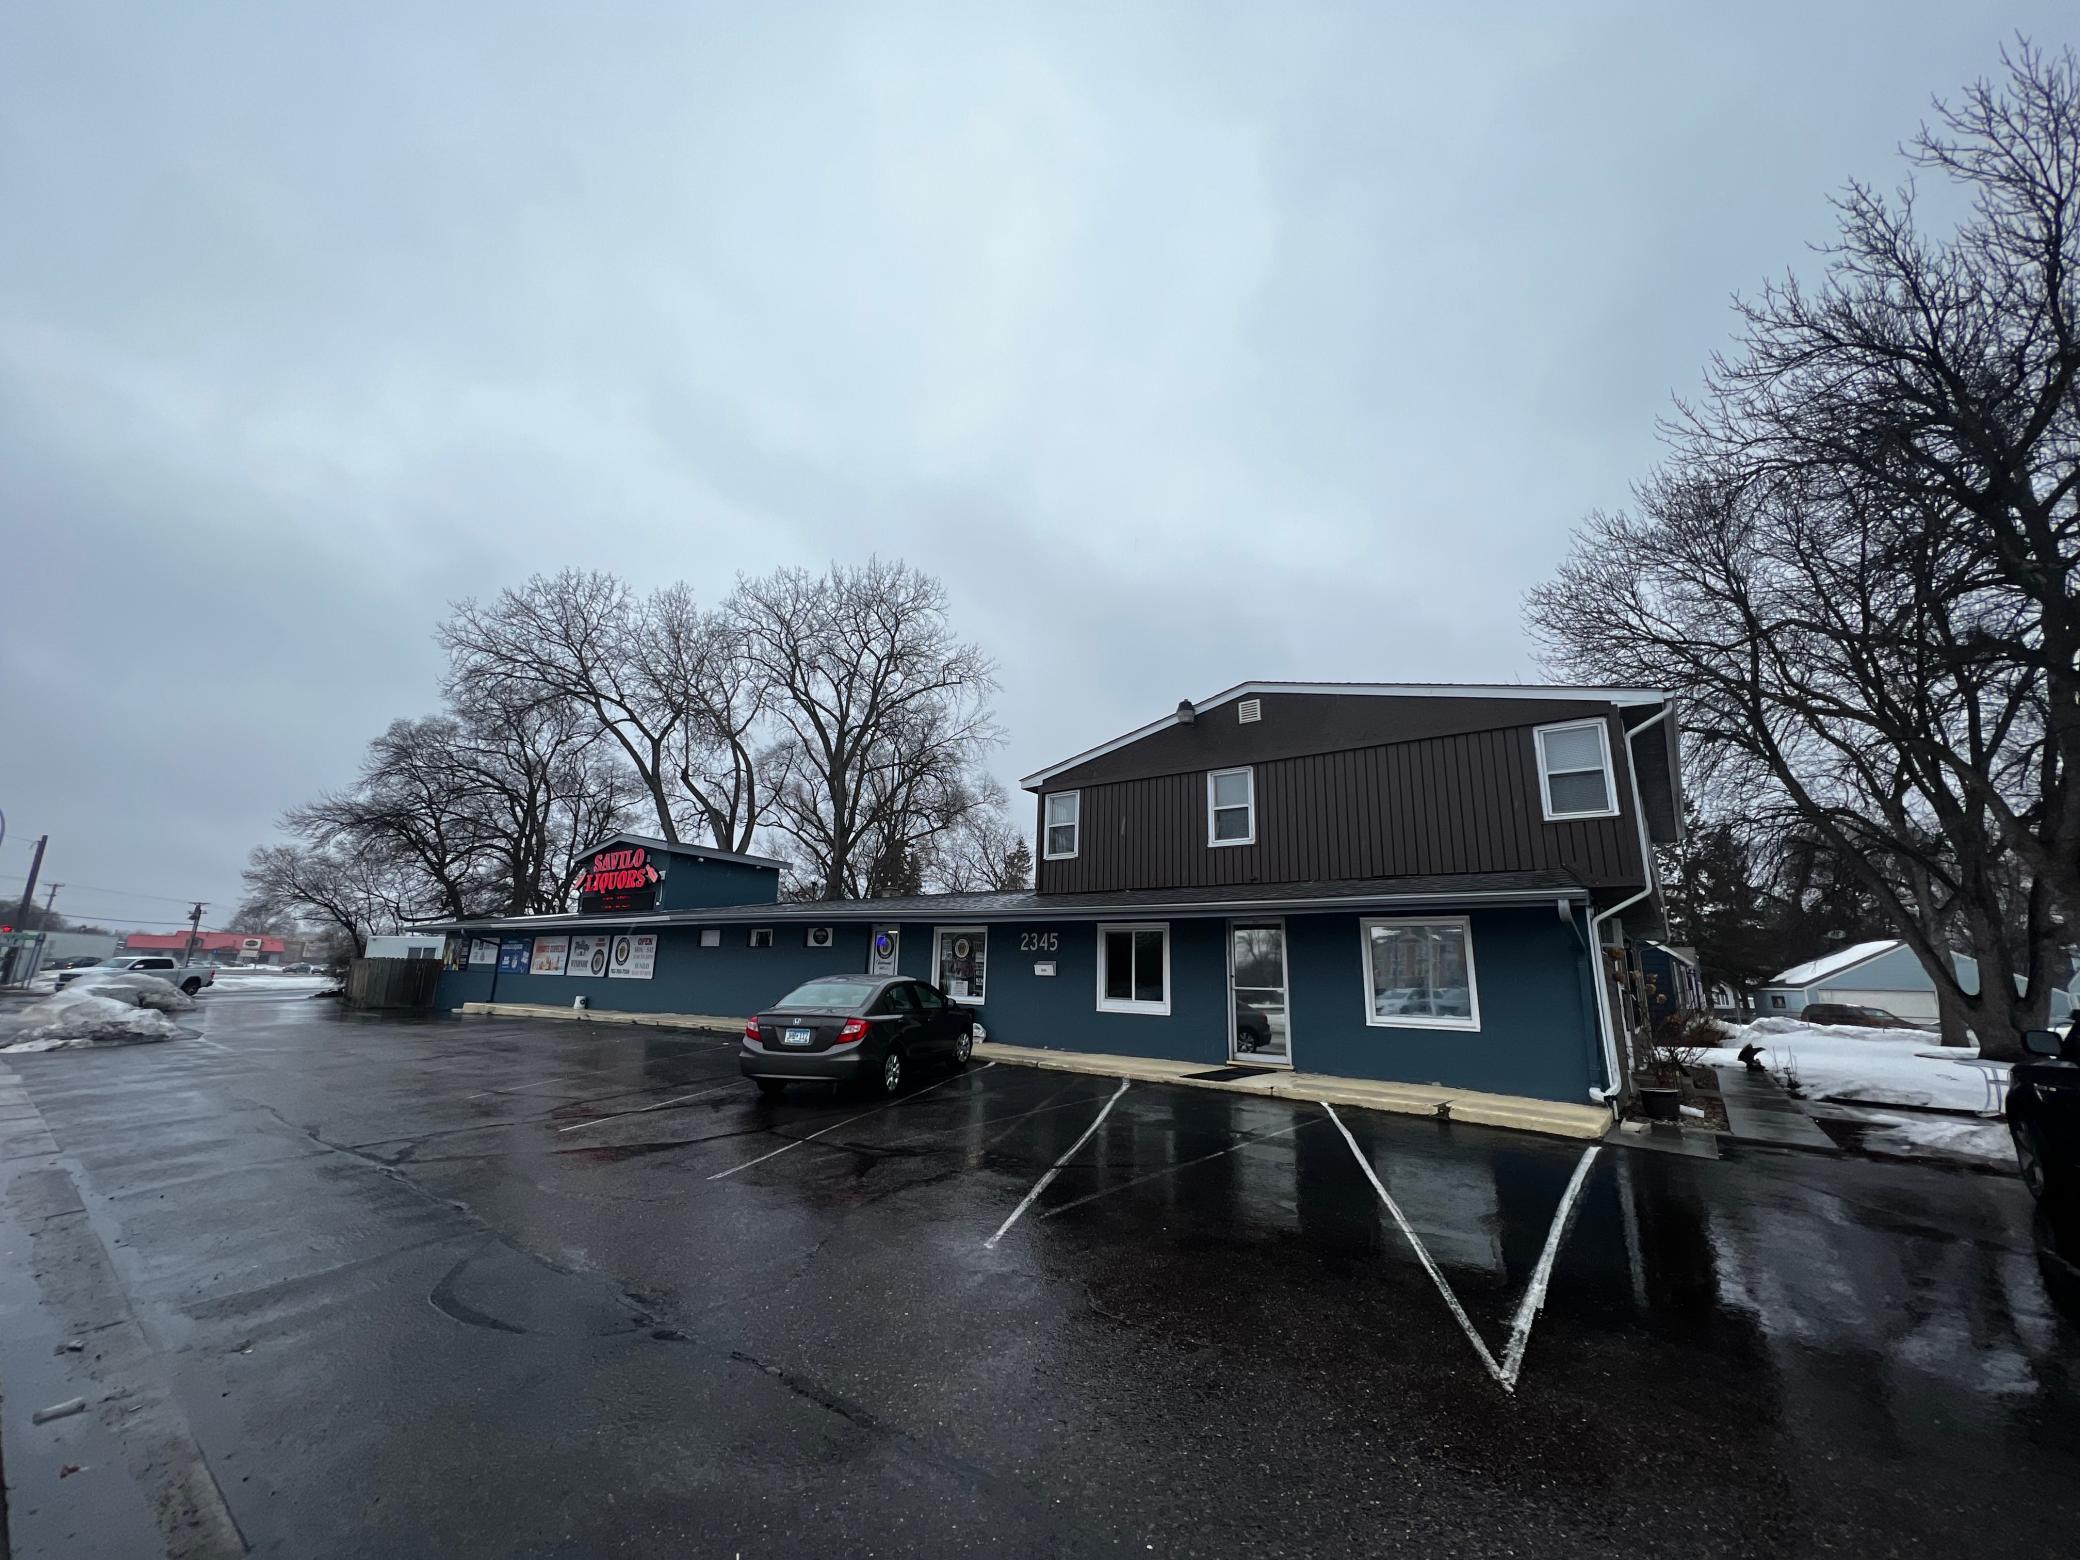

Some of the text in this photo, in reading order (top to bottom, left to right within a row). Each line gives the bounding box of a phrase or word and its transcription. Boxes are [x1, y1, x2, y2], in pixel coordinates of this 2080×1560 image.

[593, 848, 645, 872] SAVILO
[585, 869, 646, 894] LIQUORS
[638, 937, 653, 946] OPEN
[1020, 932, 1059, 951] 2345
